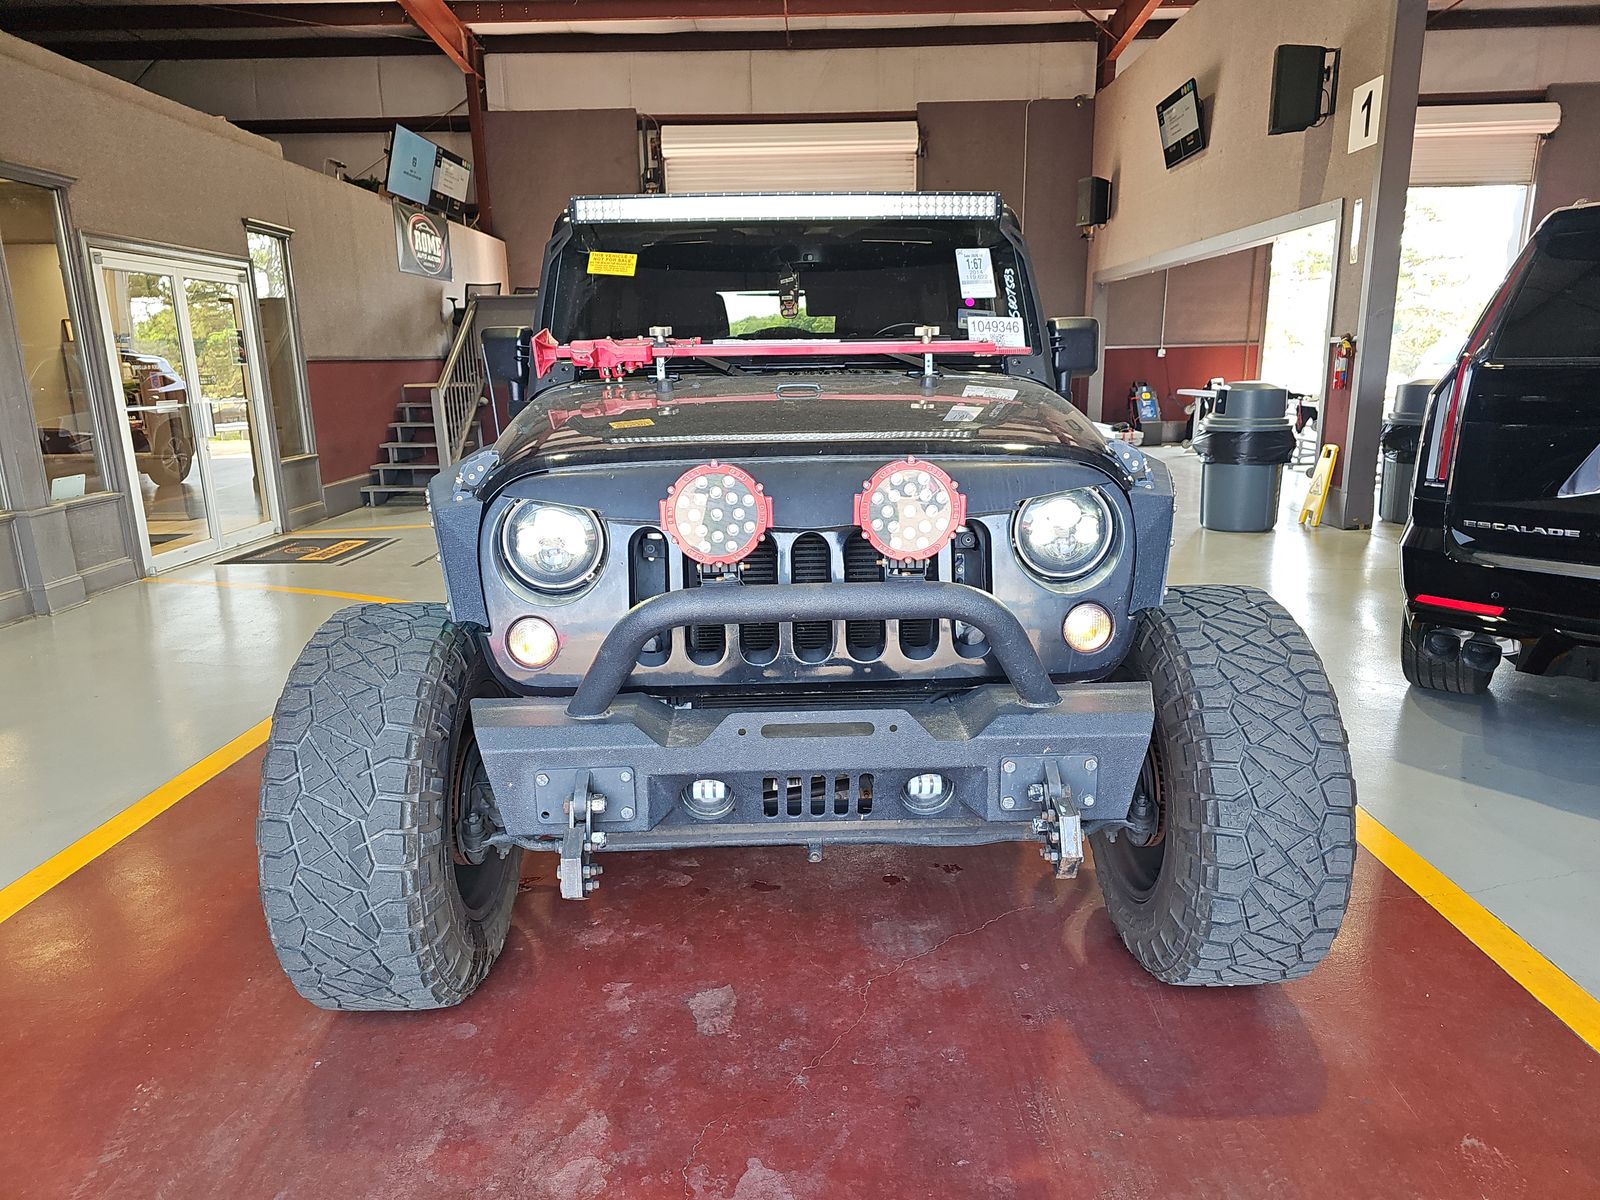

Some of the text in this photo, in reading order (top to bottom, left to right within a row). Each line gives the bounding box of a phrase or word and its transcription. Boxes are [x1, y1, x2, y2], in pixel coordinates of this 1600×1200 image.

[1361, 90, 1373, 137] 1
[413, 230, 442, 257] ROME
[966, 258, 982, 270] 1:67
[971, 320, 1020, 333] 1049346
[1463, 519, 1581, 538] ESCALADE
